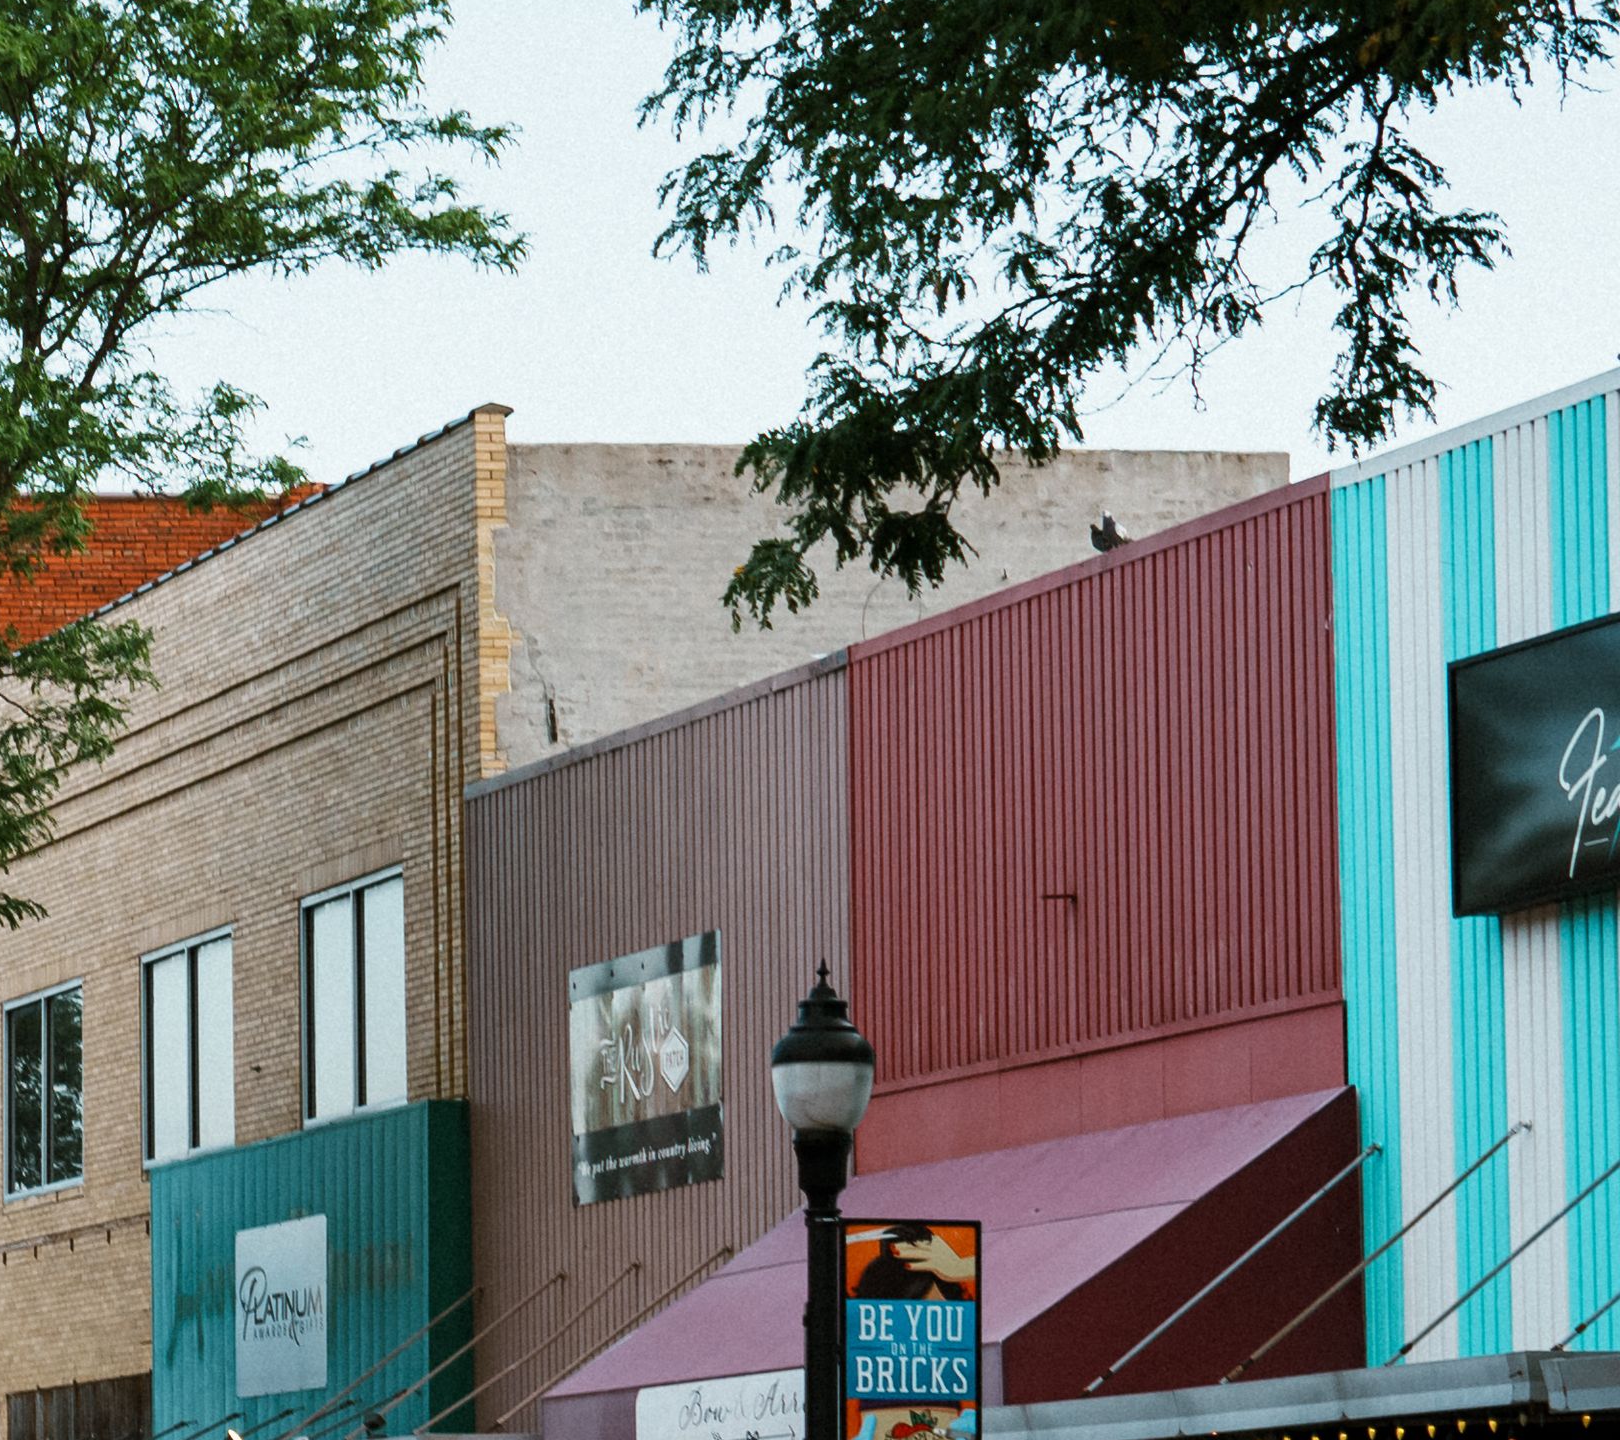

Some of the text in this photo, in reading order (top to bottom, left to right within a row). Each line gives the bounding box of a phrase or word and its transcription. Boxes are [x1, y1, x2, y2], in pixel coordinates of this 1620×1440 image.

[592, 1160, 604, 1179] put
[606, 1155, 617, 1171] the
[619, 1147, 647, 1168] warmth
[648, 1146, 656, 1161] in
[657, 1142, 686, 1159] country
[858, 1304, 964, 1342] BE YOU
[891, 1342, 933, 1356] ON THE
[855, 1356, 968, 1394] BRICKS
[753, 1378, 803, 1421] Arr
